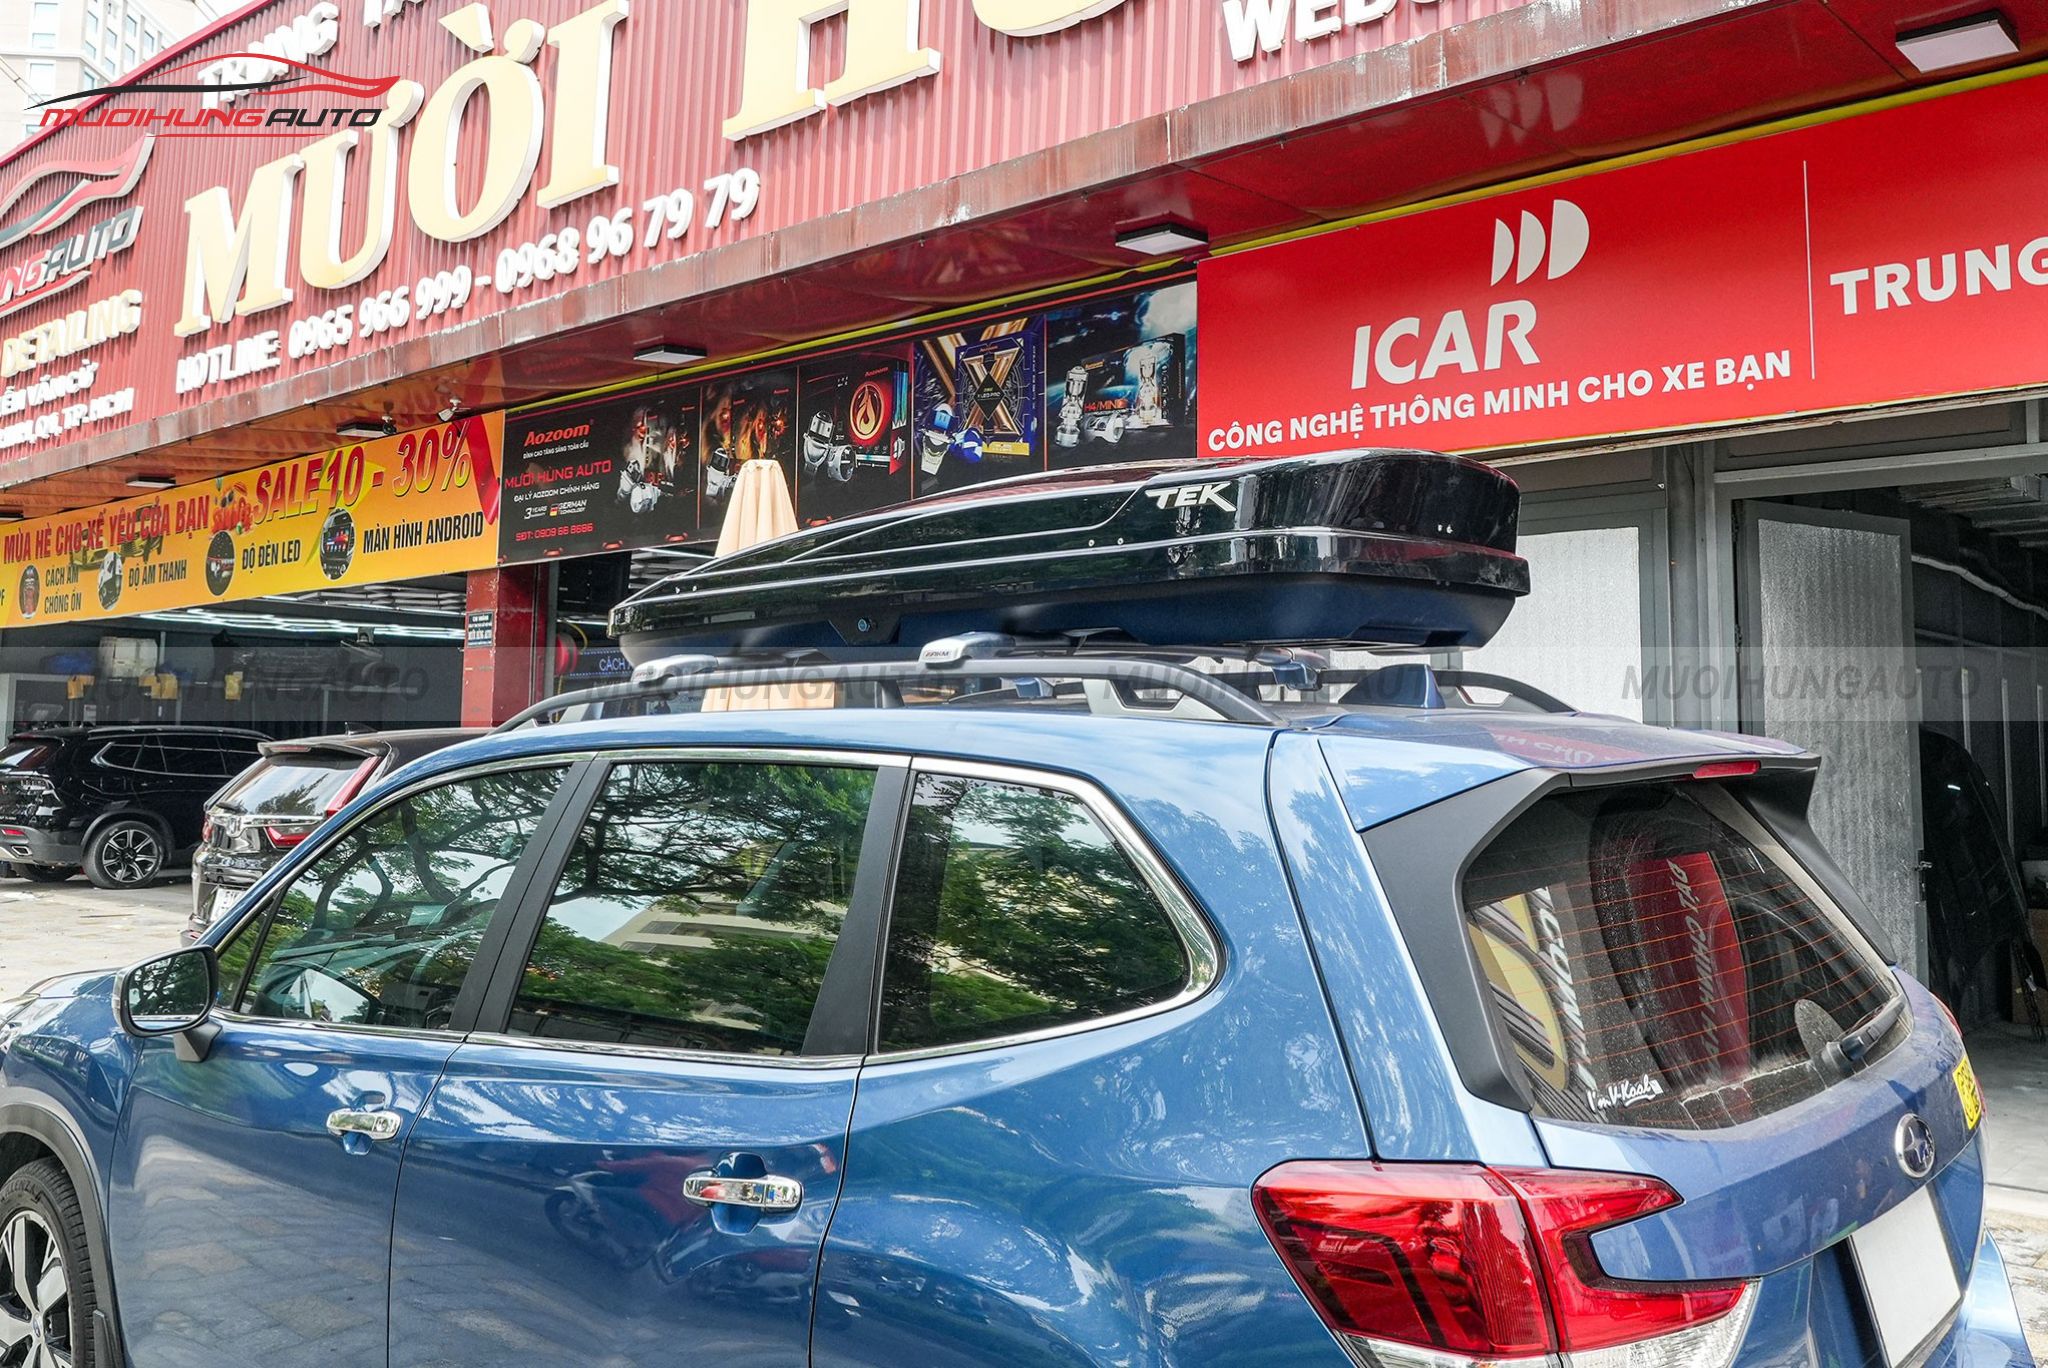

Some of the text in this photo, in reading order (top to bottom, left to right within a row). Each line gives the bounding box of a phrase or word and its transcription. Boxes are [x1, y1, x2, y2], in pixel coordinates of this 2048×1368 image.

[288, 304, 354, 360] 0965
[358, 285, 410, 338] 966
[415, 264, 472, 319] 999
[495, 226, 580, 293] 0968
[586, 207, 634, 263] 96
[642, 188, 695, 248] 79
[703, 167, 761, 228] 79
[1830, 236, 2048, 316] TRUNG
[2, 289, 142, 378] DETAILING
[1351, 300, 1541, 389] ICAR
[1208, 350, 1792, 452] CÔNG NGHỆ THÔNG MINH CHO XE BẠN
[523, 424, 590, 447] Aozoom
[254, 457, 324, 526] SALE
[327, 446, 365, 510] 10
[393, 419, 471, 498] 30%
[576, 459, 613, 476] AUTO
[1145, 481, 1237, 512] TEK
[4, 526, 32, 564] MÙA
[35, 521, 51, 560] HÈ
[56, 518, 82, 556] CHO
[109, 506, 138, 546] YÊU
[140, 495, 170, 538] CỦA
[175, 494, 210, 540] BẠN
[241, 539, 301, 574] ĐỘ ĐÈN LED
[363, 511, 484, 554] MÀN HÌNH ANDROID
[158, 560, 187, 582] THANH
[599, 656, 626, 672] CÁCH
